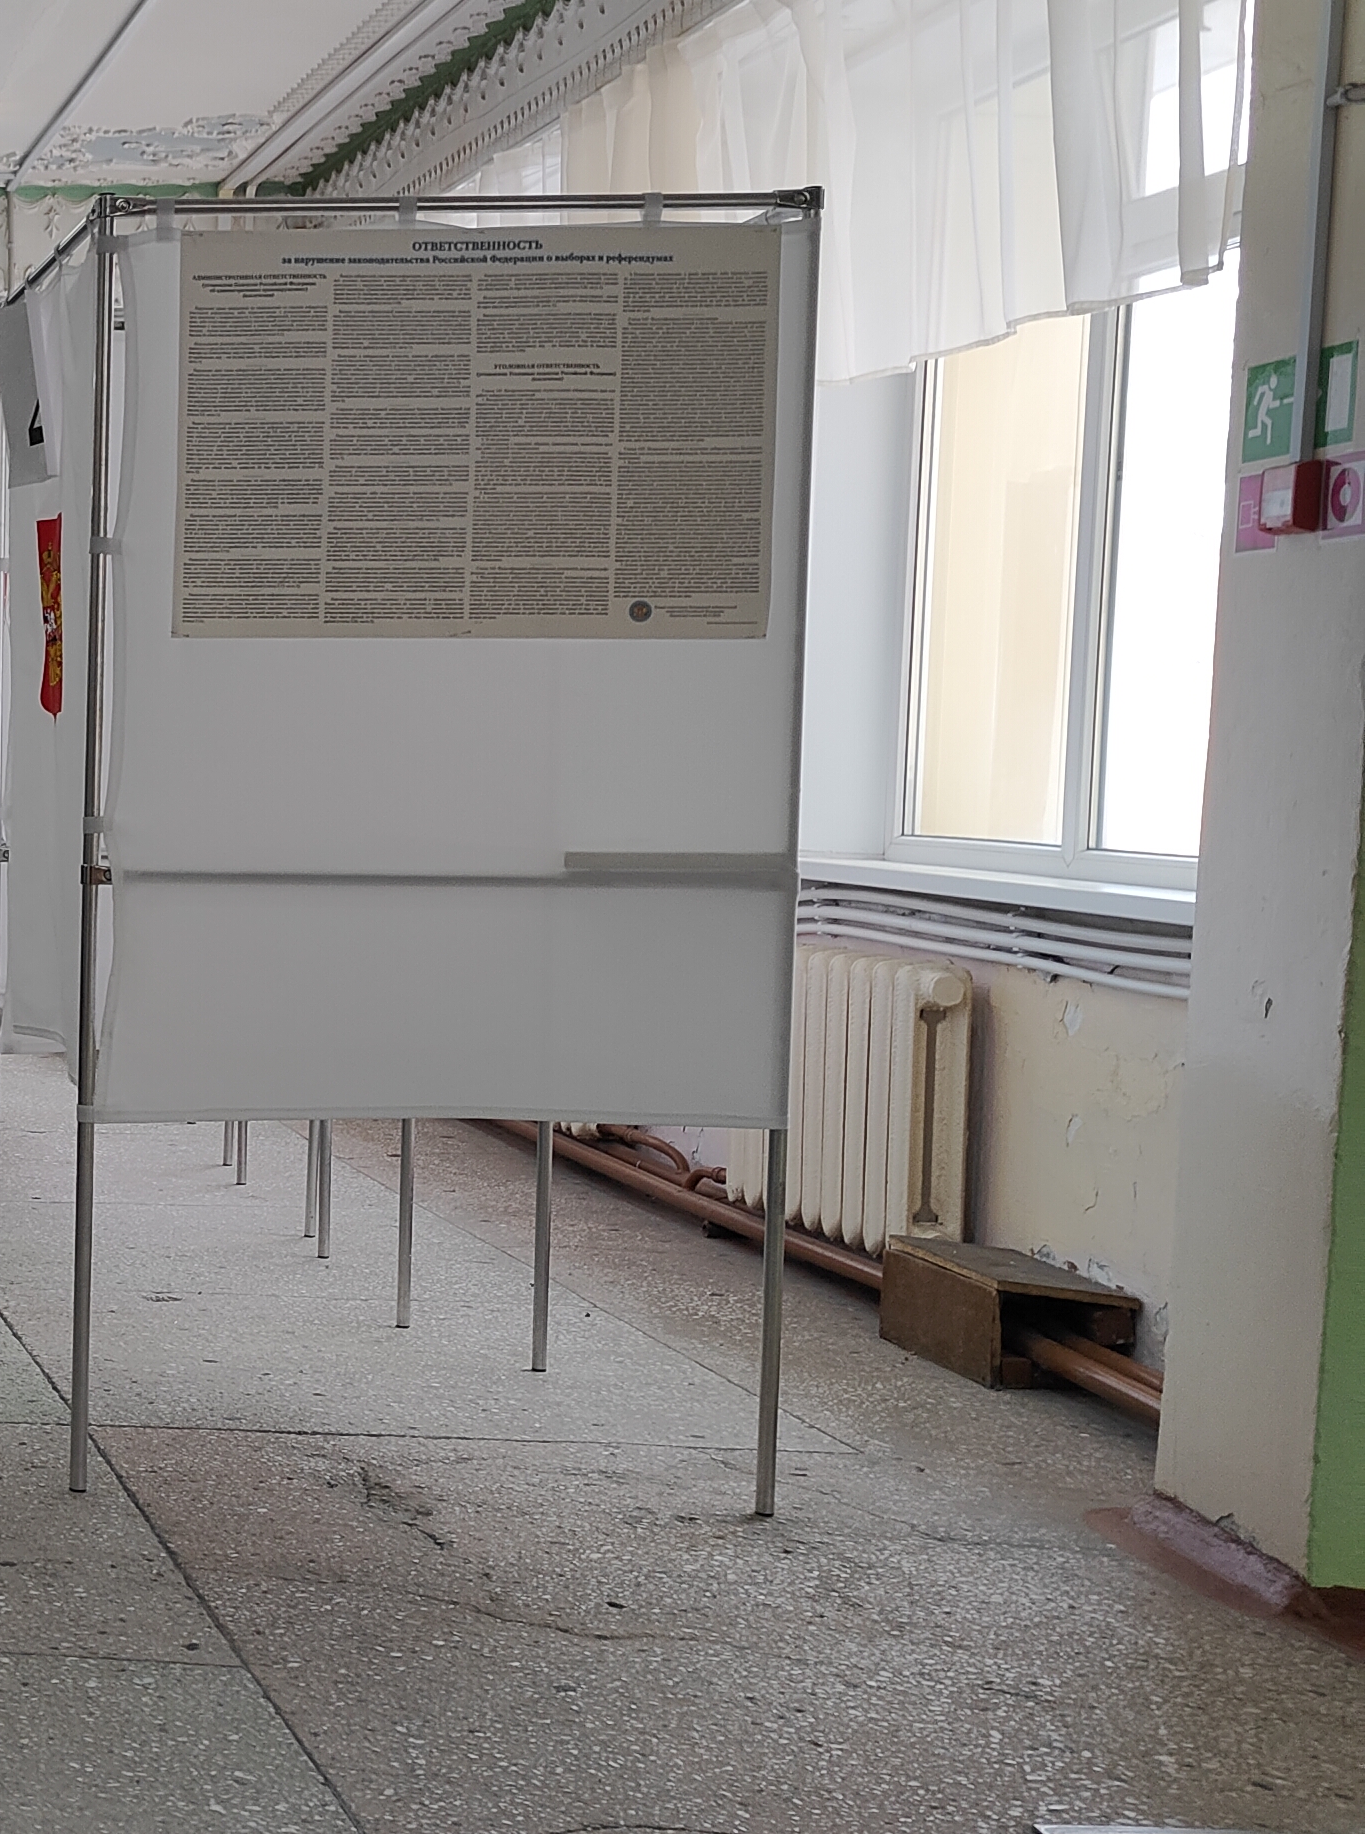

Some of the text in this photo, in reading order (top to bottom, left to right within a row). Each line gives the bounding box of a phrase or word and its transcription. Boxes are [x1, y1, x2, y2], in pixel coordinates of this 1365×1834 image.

[412, 240, 543, 252] ОТВЕТСТВЕННОСТЬ
[294, 256, 346, 267] нарушение
[348, 255, 431, 265] законодательства
[432, 254, 488, 264] Российской
[489, 253, 544, 265] Федерации
[554, 252, 596, 263] выборах
[606, 252, 674, 265] референдумах
